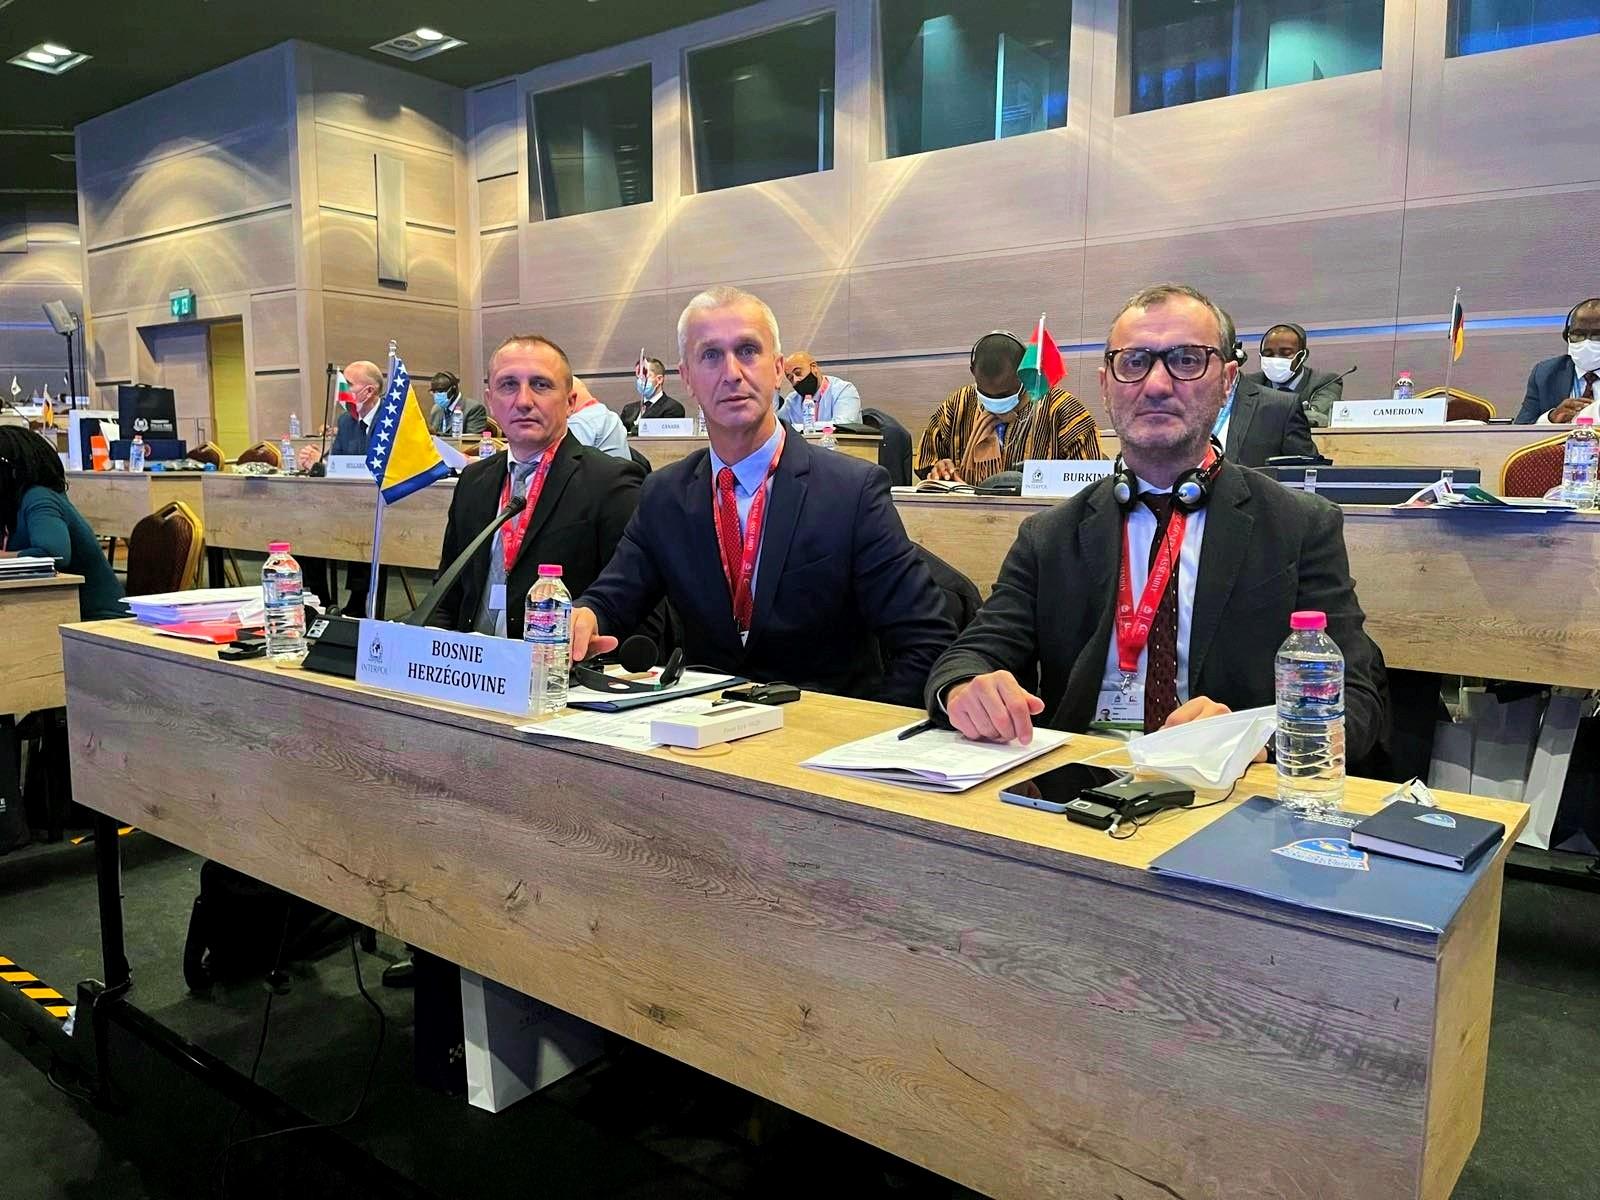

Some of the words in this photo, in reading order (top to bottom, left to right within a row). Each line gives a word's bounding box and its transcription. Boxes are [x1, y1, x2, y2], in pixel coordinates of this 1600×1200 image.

[1373, 407, 1424, 416] CAMEROUN
[1063, 471, 1110, 482] BURKIN
[432, 640, 483, 664] BOSNIE
[408, 662, 506, 695] HERZÉGOVINE
